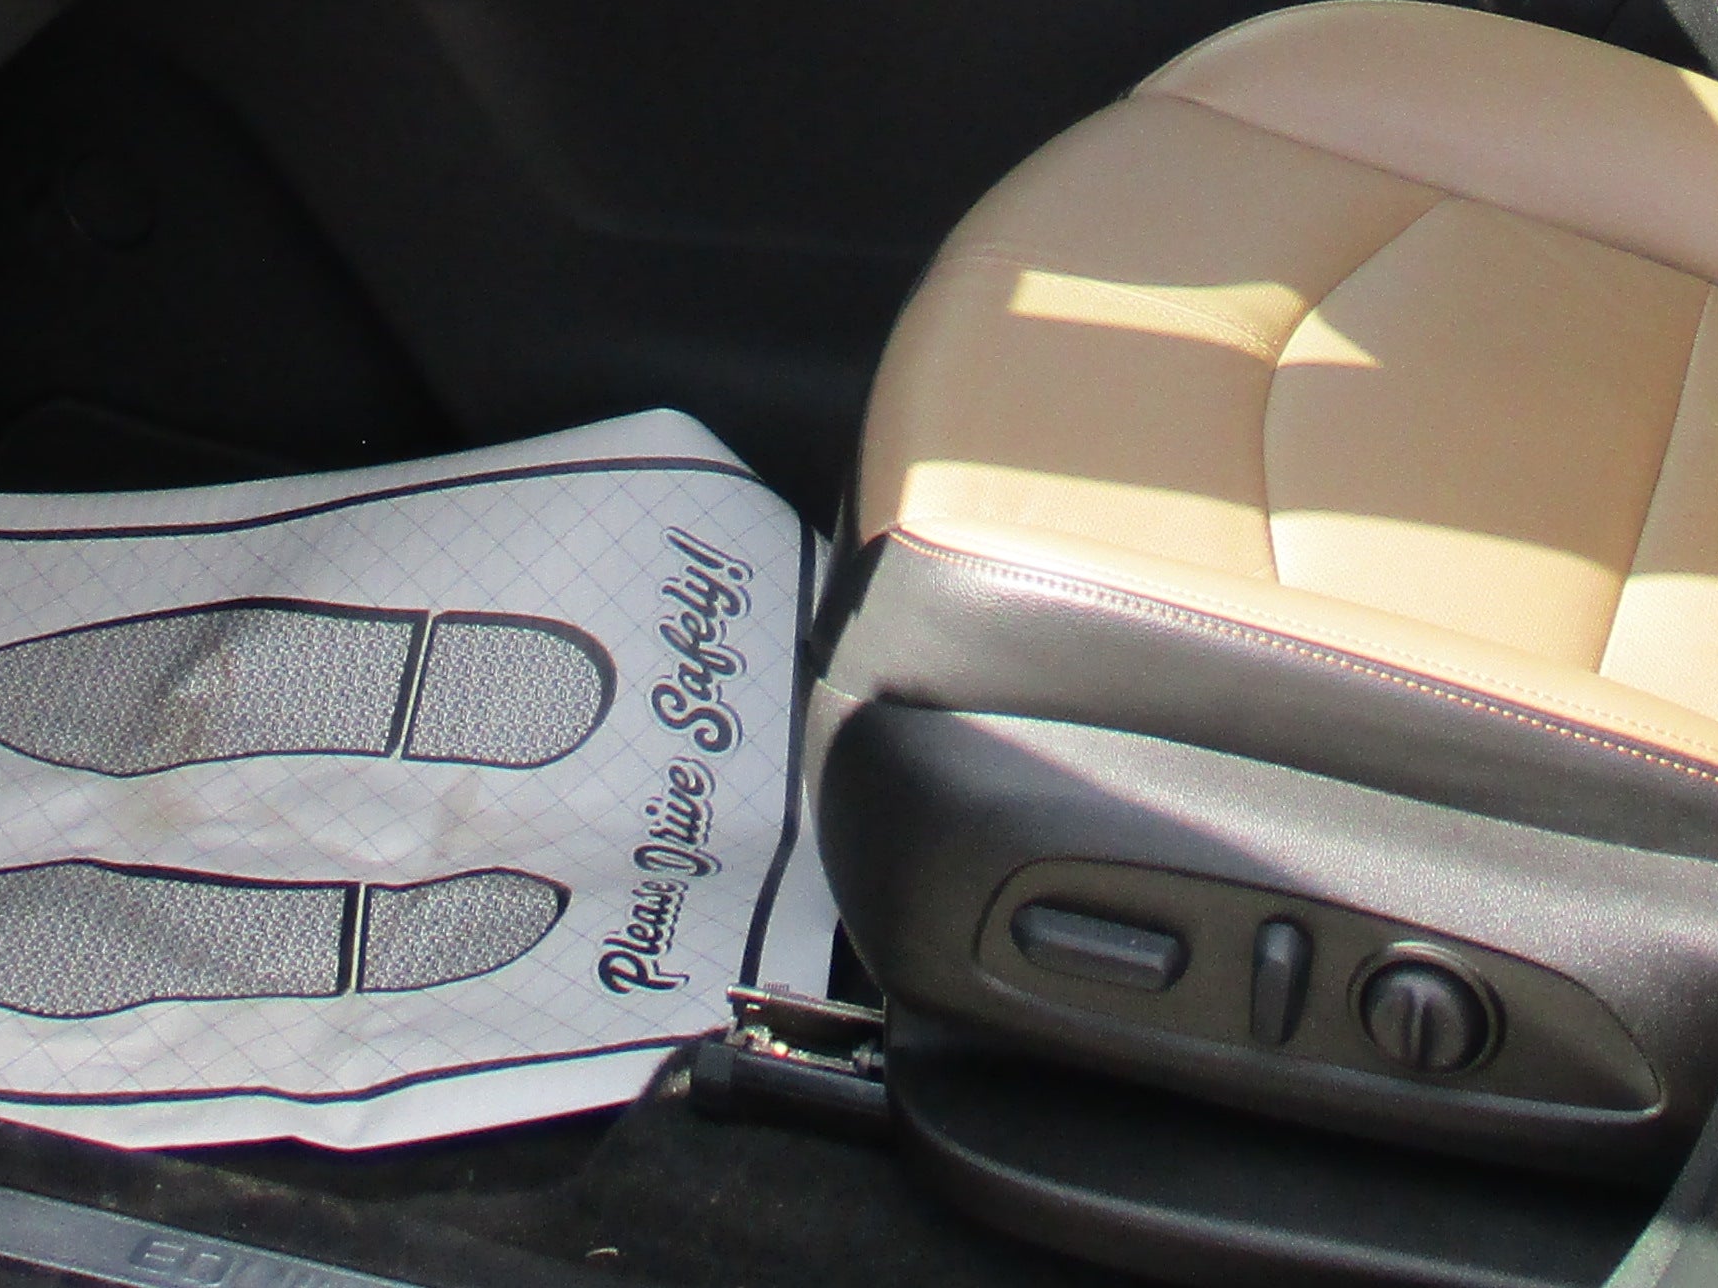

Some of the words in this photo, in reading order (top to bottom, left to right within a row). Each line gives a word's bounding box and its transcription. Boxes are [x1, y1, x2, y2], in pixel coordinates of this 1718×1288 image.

[651, 526, 754, 754] Safely!
[632, 757, 721, 879] Drive
[597, 876, 689, 996] Please
